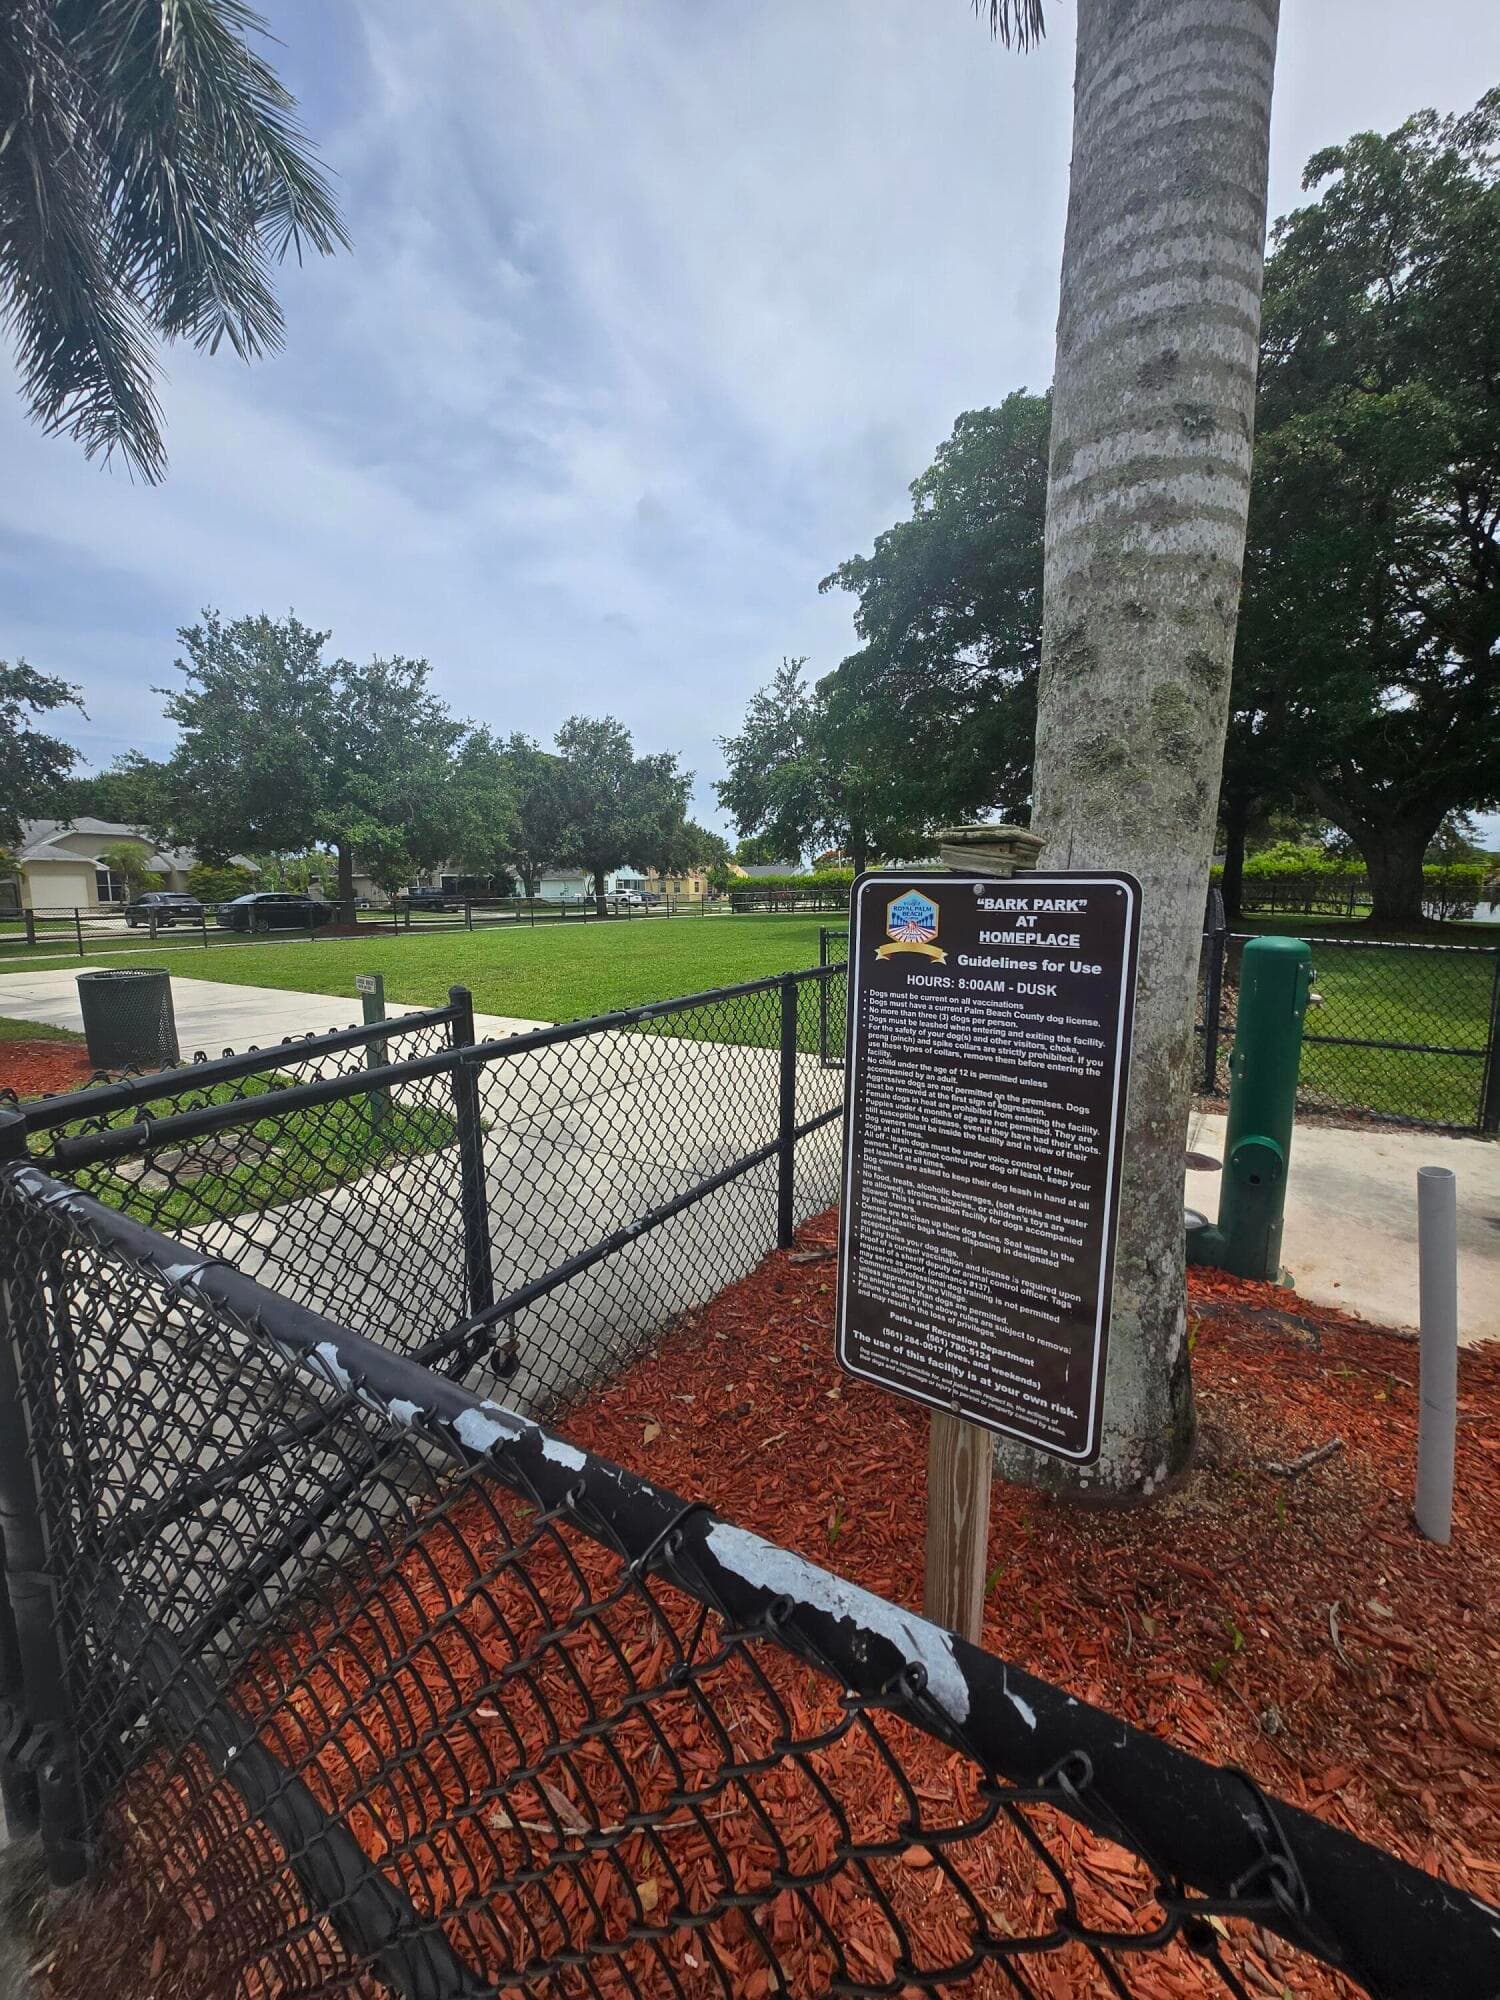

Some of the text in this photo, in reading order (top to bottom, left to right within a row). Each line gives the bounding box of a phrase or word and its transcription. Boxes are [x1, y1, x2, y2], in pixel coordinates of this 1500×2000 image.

[977, 898, 1087, 911] “BARK PARK”
[1015, 915, 1037, 927] AT
[979, 930, 1080, 946] HOMEPLACE
[957, 954, 1101, 974] Guidelines for Use
[869, 989, 887, 997] Dogs
[972, 999, 1023, 1009] vaccinations
[907, 974, 954, 987] HOURS:
[958, 978, 1004, 992] 8:00AM
[1017, 982, 1056, 996] DUSK
[869, 997, 887, 1005] Dogs
[964, 1006, 984, 1014] Palm
[986, 1008, 1011, 1017] Beach
[1013, 1011, 1044, 1022] County
[1046, 1014, 1063, 1024] dog
[939, 1013, 948, 1021] (3)
[950, 1014, 970, 1023] dogs
[987, 1019, 1018, 1028] person.
[869, 1014, 886, 1022] Dogs
[919, 1020, 948, 1028] leashed
[949, 1023, 970, 1031] when
[972, 1026, 1006, 1036] entering
[1025, 1032, 1054, 1042] exiting
[1073, 1036, 1105, 1048] facility.
[894, 1026, 916, 1034] safety
[946, 1031, 971, 1041] dog(s)
[989, 1037, 1011, 1045] other
[1013, 1039, 1047, 1051] visitors,
[1049, 1044, 1079, 1055] choke,
[881, 1040, 901, 1048] these
[903, 1044, 922, 1052] types
[933, 1048, 961, 1058] collars,
[963, 1052, 993, 1061] remove
[995, 1055, 1015, 1064] them
[1017, 1058, 1044, 1068] before
[1046, 1063, 1083, 1075] entering
[1086, 1067, 1100, 1075] the
[890, 1033, 915, 1043] (pinch)
[932, 1039, 953, 1047] spike
[954, 1042, 981, 1050] collars
[997, 1047, 1026, 1057] strictly
[1028, 1051, 1075, 1063] prohibited.
[1086, 1058, 1103, 1066] you
[878, 1057, 895, 1065] child
[978, 1072, 1017, 1083] permitted
[1019, 1078, 1047, 1087] unless
[866, 1072, 905, 1084] Aggressive
[907, 1078, 925, 1087] dogs
[955, 1087, 992, 1098] permitted
[1006, 1094, 1020, 1102] the
[1021, 1097, 1063, 1109] premises.
[1066, 1103, 1089, 1114] Dogs
[866, 1089, 890, 1097] Female
[892, 1093, 910, 1102] dogs
[920, 1097, 936, 1105] heat
[951, 1104, 992, 1116] prohibited
[993, 1109, 1012, 1119] from
[1014, 1114, 1049, 1127] entering
[1051, 1120, 1065, 1128] the
[1068, 1122, 1099, 1135] facility.
[890, 1311, 1034, 1366] Parks and Recreation Department
[853, 1329, 1077, 1418] The use of this facility is at your own risk.
[945, 1347, 970, 1364] (eves.
[972, 1360, 989, 1370] and
[991, 1366, 1040, 1390] weekends)
